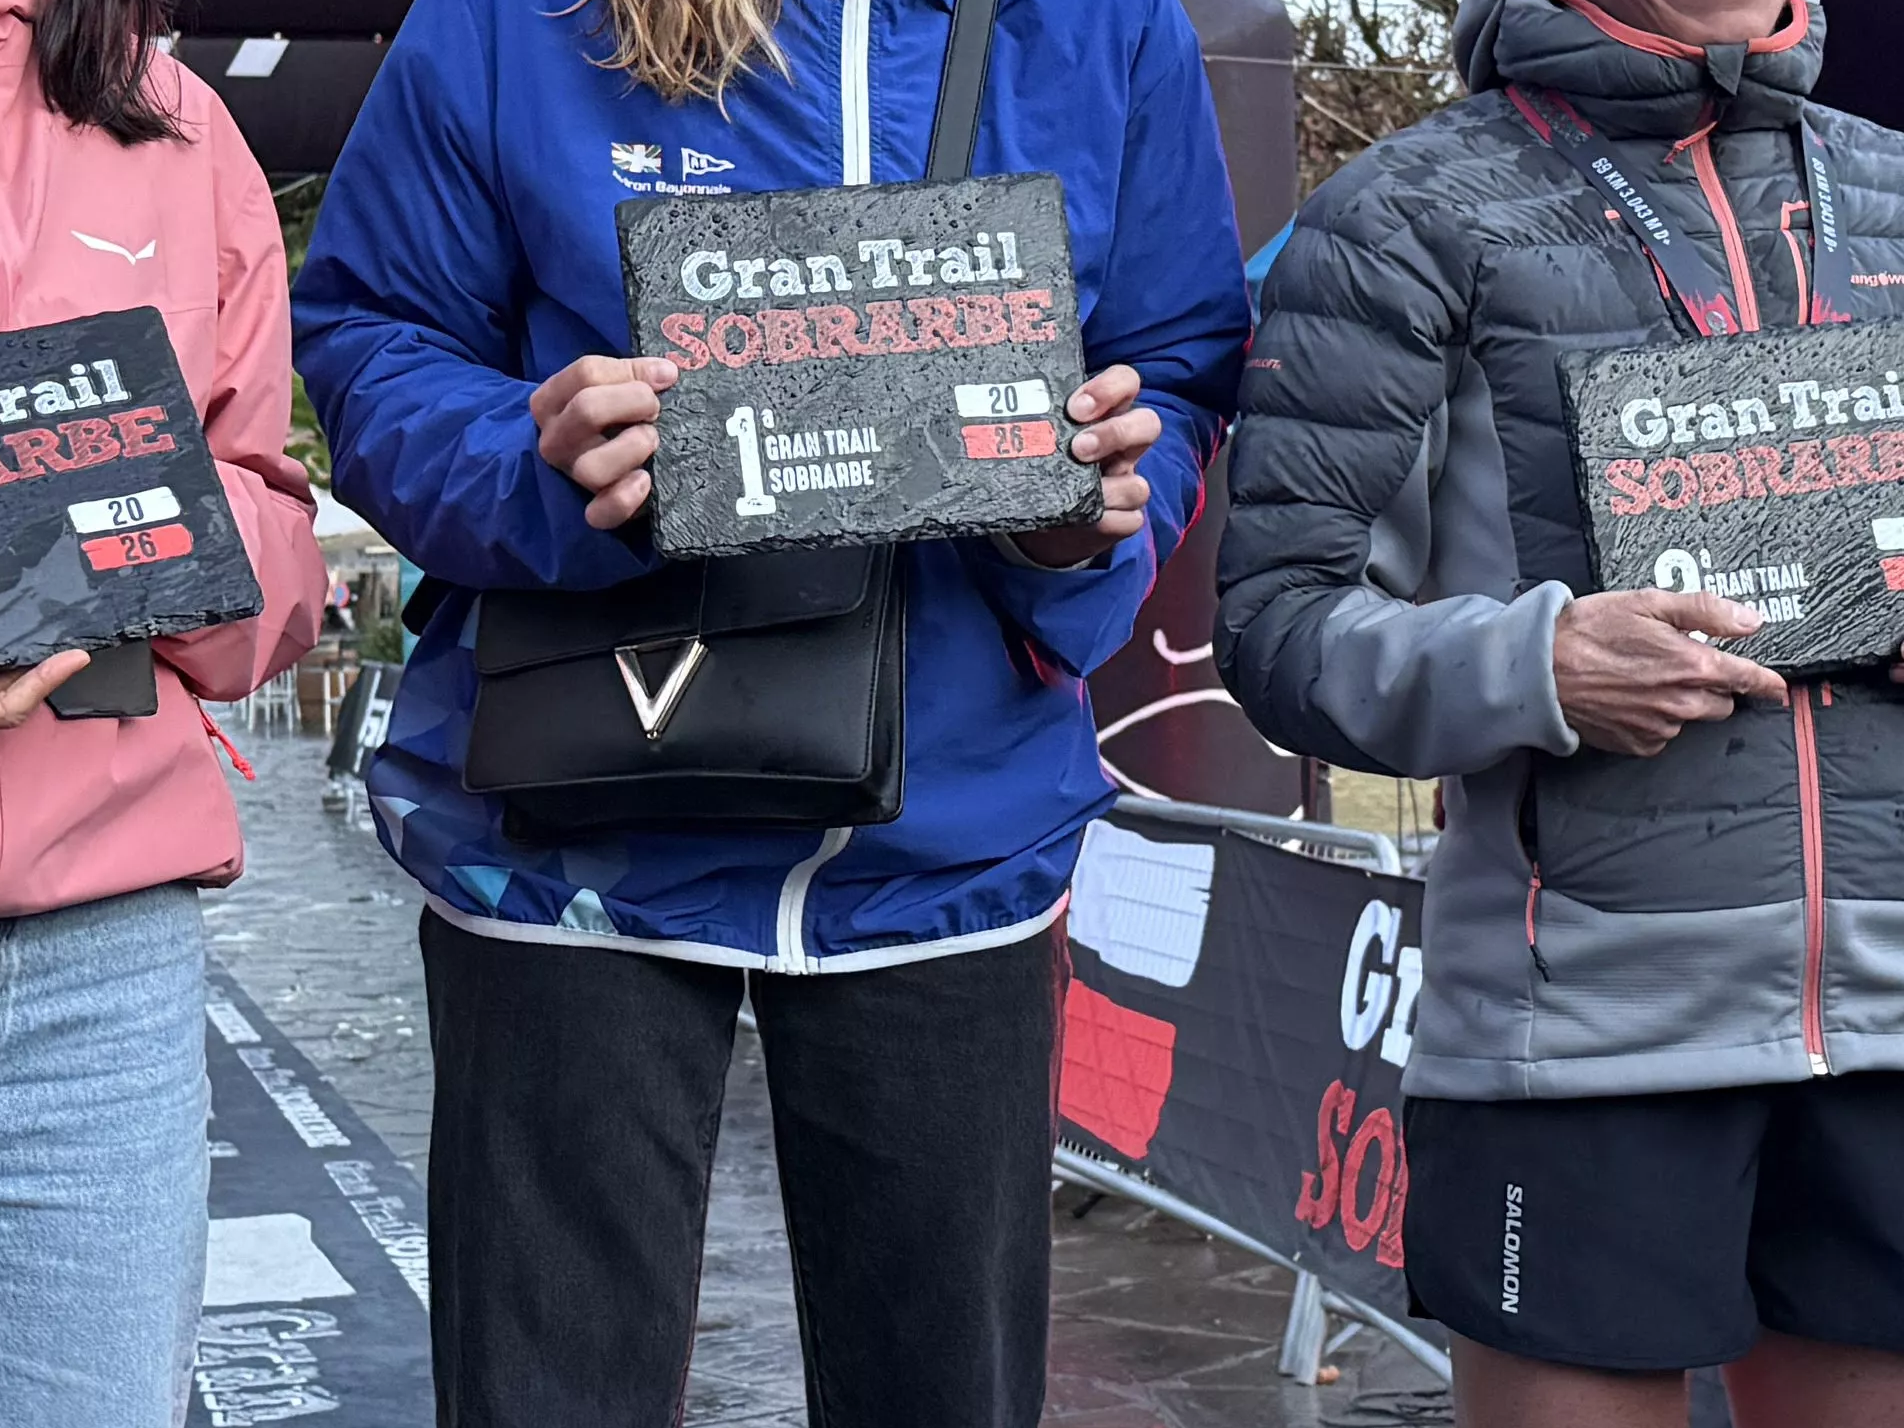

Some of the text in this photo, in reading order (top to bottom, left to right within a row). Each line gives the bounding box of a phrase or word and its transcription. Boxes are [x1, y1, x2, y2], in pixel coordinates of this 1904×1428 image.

[1591, 157, 1613, 175] 69
[1603, 170, 1629, 191] KM
[1618, 187, 1654, 219] 3.043
[1643, 217, 1663, 231] M
[680, 231, 1023, 301] Gran Trail
[659, 289, 1056, 370] SOBRARBE
[989, 385, 1019, 414] 20
[996, 424, 1024, 453] 26
[1620, 397, 1776, 448] Gran
[765, 427, 882, 461] GRAN TRAIL
[769, 460, 875, 493] SOBRARBE
[107, 497, 144, 526] 20
[121, 533, 156, 560] 26
[1704, 562, 1810, 597] GRAN TRAIL
[1341, 899, 1422, 1068] Gr
[1501, 1183, 1524, 1314] SALOMON
